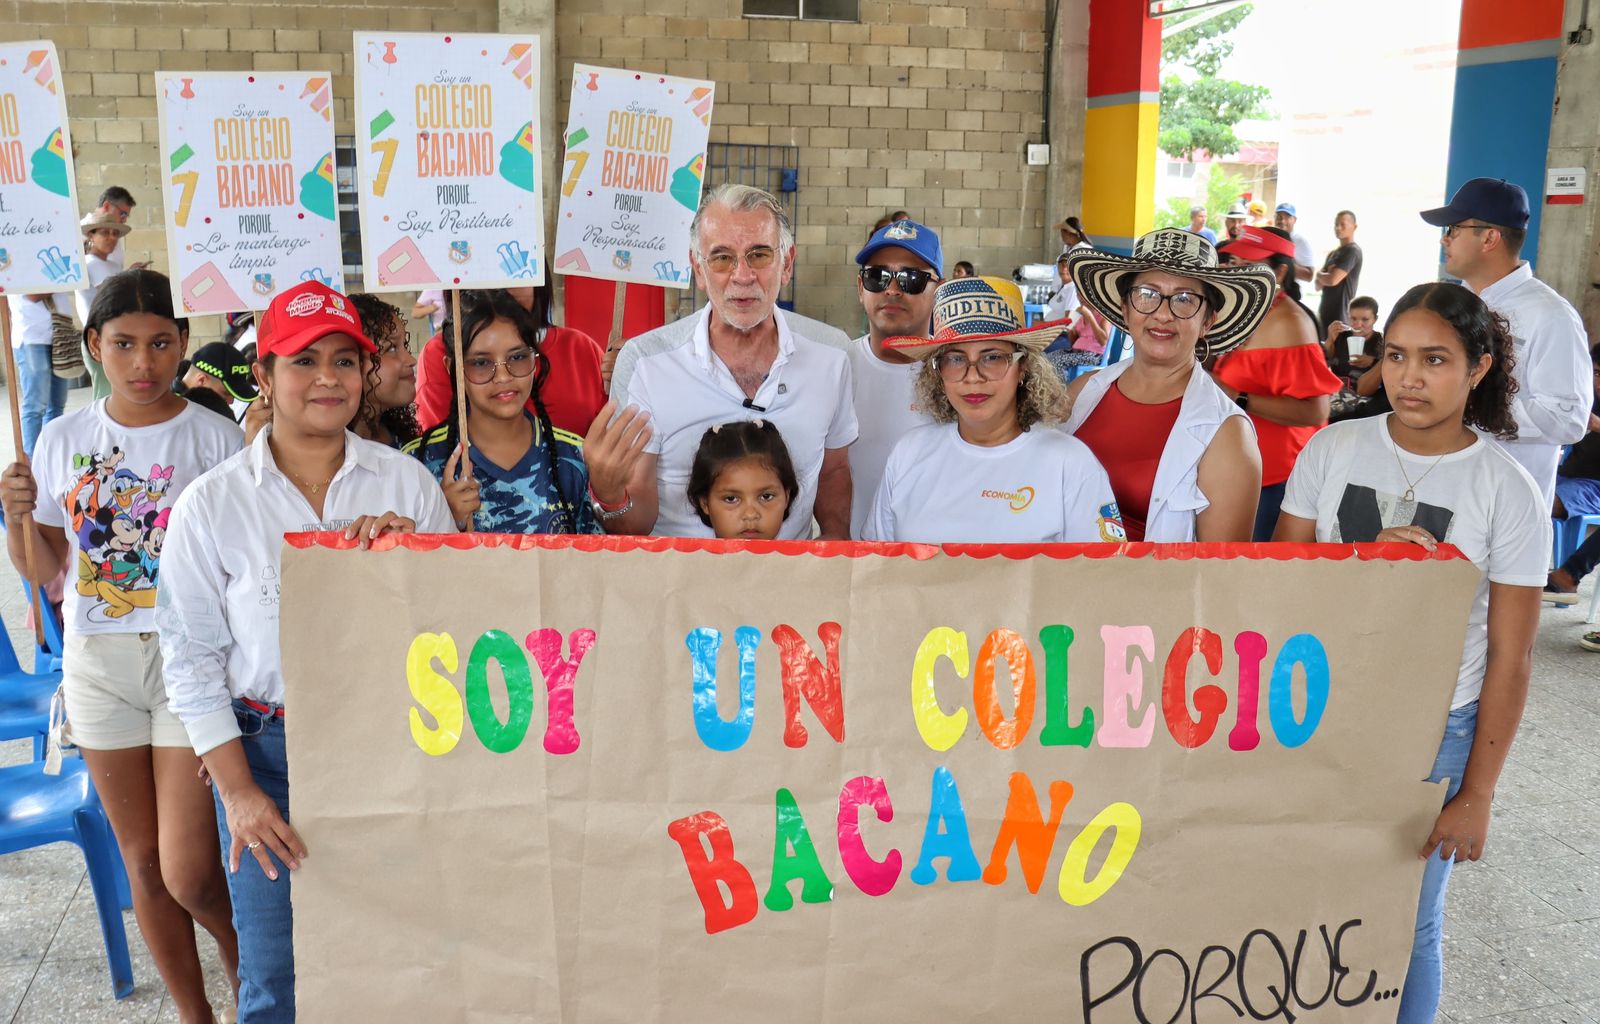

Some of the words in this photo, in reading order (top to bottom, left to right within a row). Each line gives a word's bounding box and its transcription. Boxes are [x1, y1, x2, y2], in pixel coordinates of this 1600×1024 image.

[434, 69, 456, 88] Soy
[459, 75, 473, 84] un
[232, 104, 254, 122] Soy
[415, 83, 493, 129] COLEGIO
[626, 100, 645, 117] Soy
[646, 107, 658, 115] un
[213, 117, 292, 162] COLEGIO
[606, 110, 673, 154] COLEGIO
[416, 131, 494, 178] BACANO
[601, 149, 669, 194] BACANO
[216, 163, 295, 209] BACANO
[24, 217, 54, 237] leer
[397, 209, 434, 240] Soy
[438, 207, 514, 235] Resiliente
[582, 224, 667, 251] Responsable
[611, 213, 641, 238] Soy
[192, 232, 230, 254] Lo
[234, 235, 311, 256] mantengo
[228, 252, 278, 276] limpio
[406, 628, 596, 756] SOY
[685, 621, 845, 752] UN
[911, 624, 1329, 751] COLEGIO
[668, 766, 1141, 935] BACANO
[1080, 918, 1399, 1024] PORQUE...
